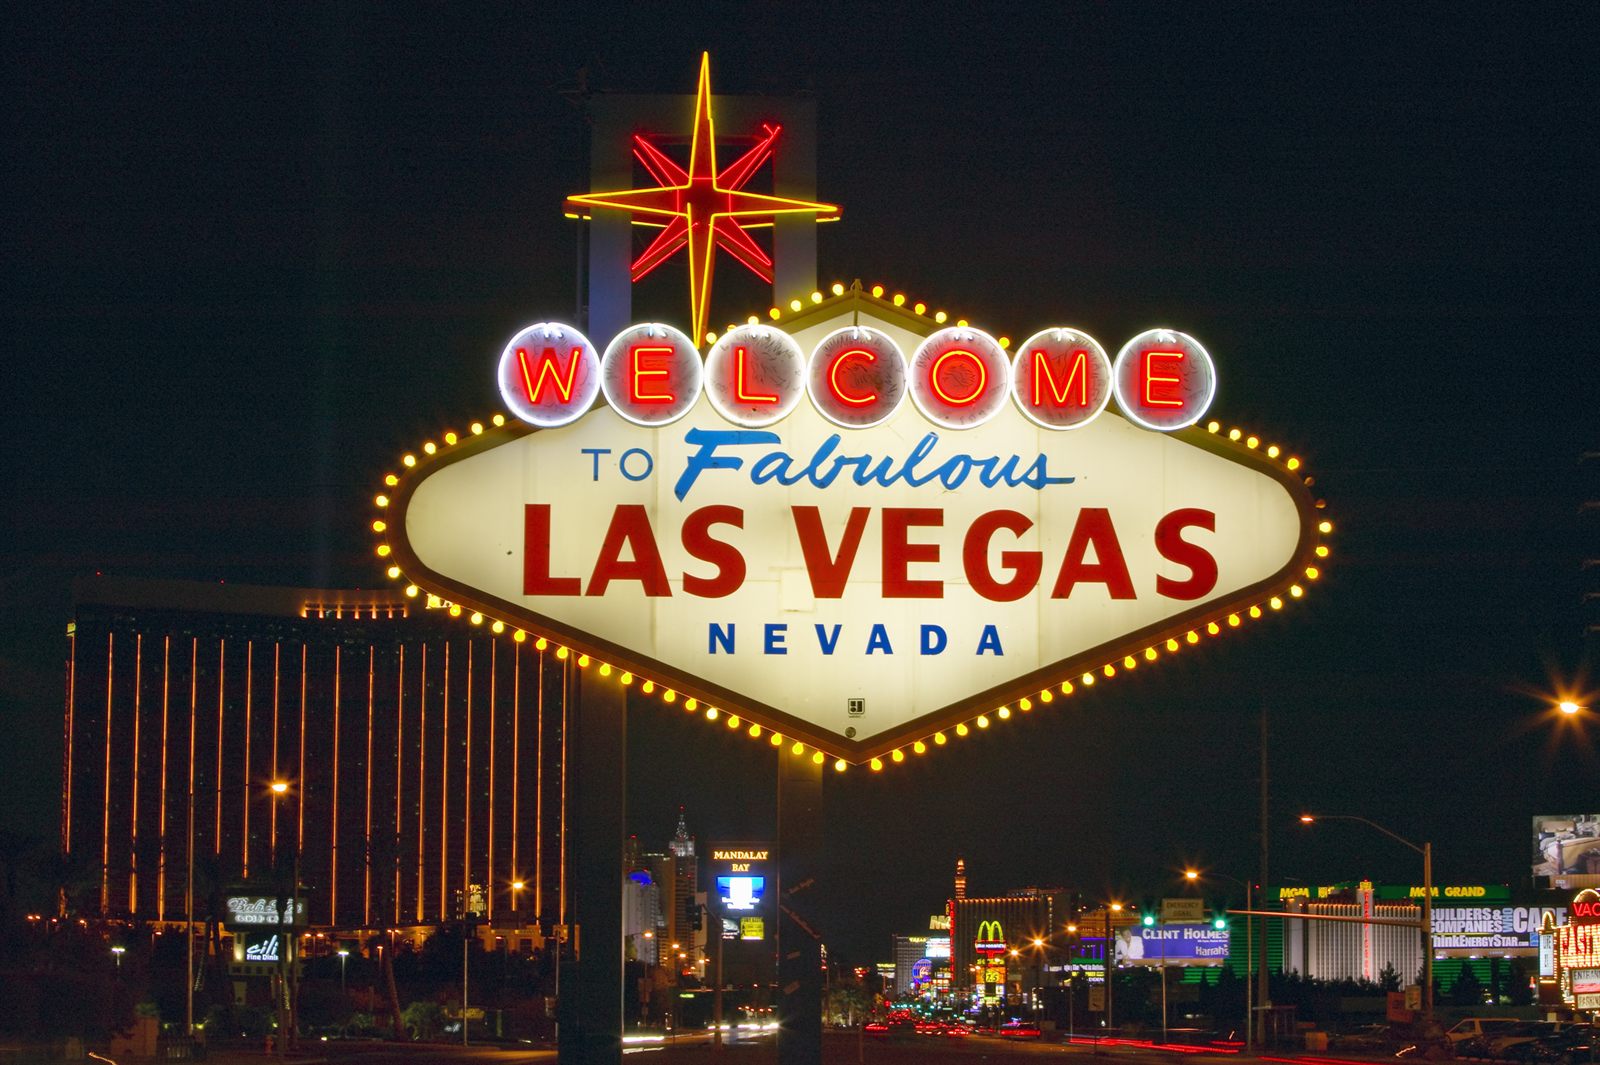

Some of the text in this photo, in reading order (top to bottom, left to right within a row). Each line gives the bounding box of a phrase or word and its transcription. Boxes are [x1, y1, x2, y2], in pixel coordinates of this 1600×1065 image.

[515, 345, 1185, 409] WELCOME
[582, 427, 1073, 501] TO Fabulous
[524, 504, 1218, 602] LAS VEGAS
[708, 623, 1003, 656] NEVADA
[714, 851, 769, 860] MANDALAY
[731, 863, 751, 872] BAY
[1280, 887, 1310, 898] MGM
[1409, 886, 1486, 897] MGM GRAND
[1502, 907, 1513, 933] WHO
[1142, 928, 1230, 940] CLINT HOLMES
